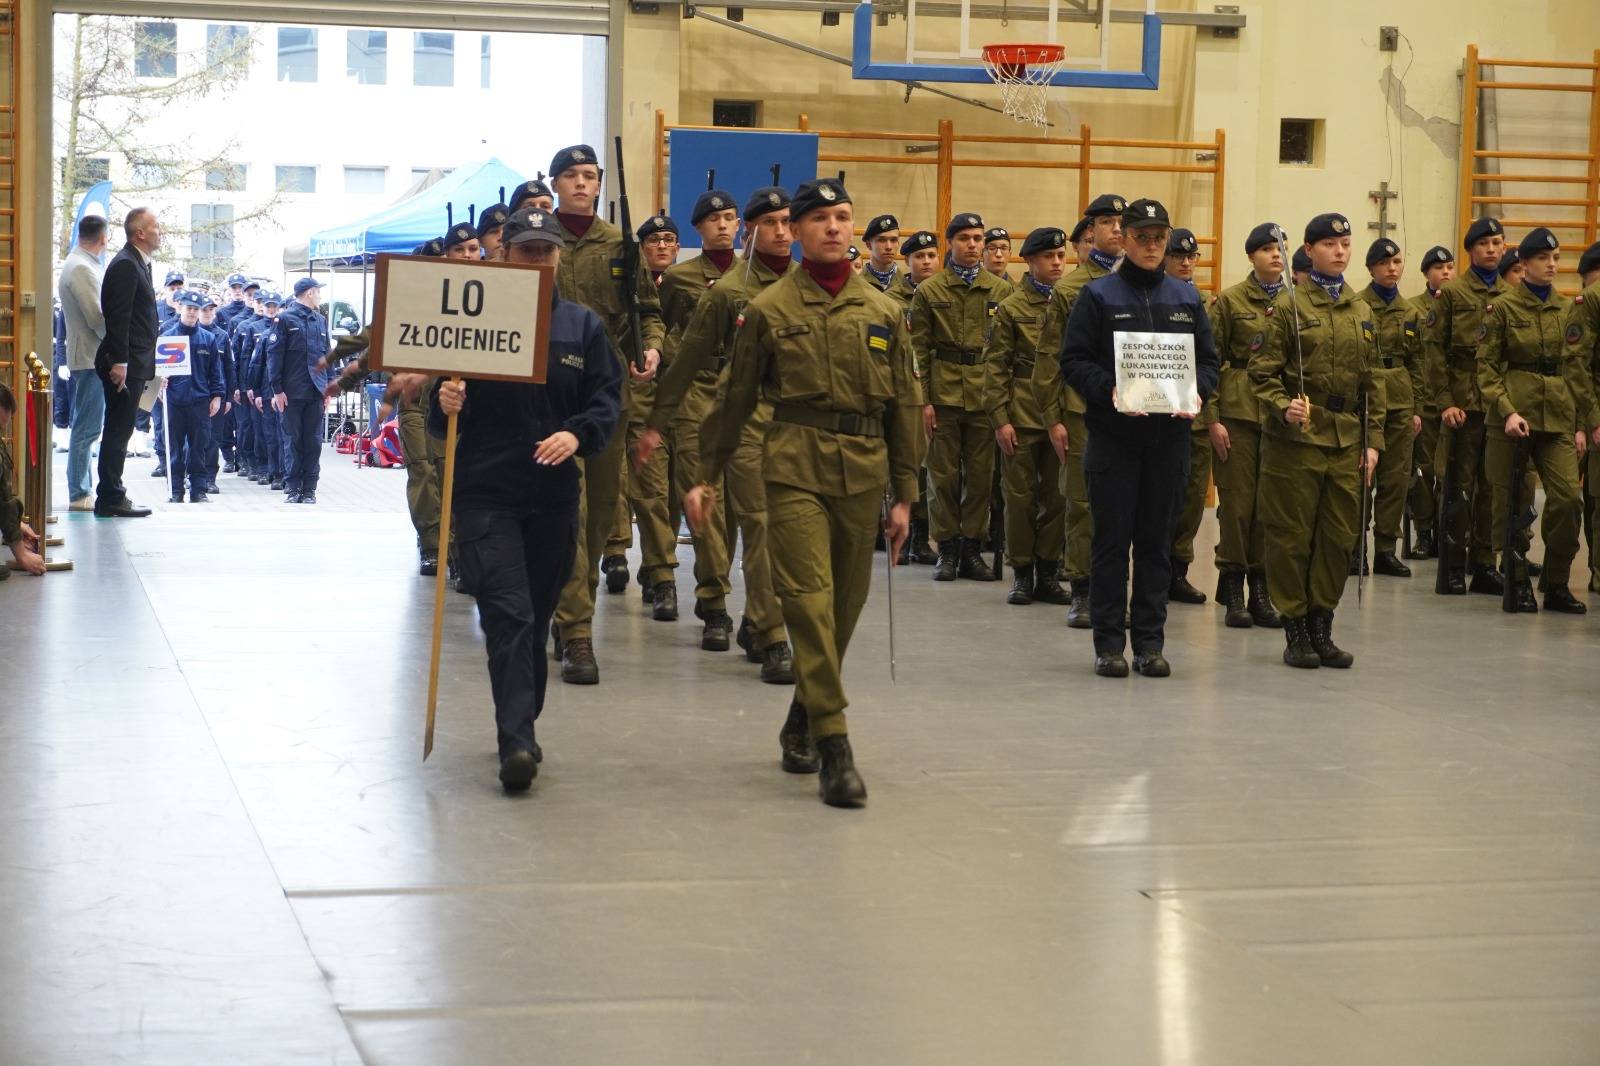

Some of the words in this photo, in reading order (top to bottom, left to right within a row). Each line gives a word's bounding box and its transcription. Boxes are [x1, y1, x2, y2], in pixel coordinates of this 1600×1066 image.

[440, 278, 485, 317] LO
[398, 323, 521, 354] ZŁOCIENIEC
[1121, 342, 1155, 351] ZESPÓŁ
[1157, 342, 1187, 351] SZKÓŁ
[1122, 352, 1136, 360] IM.
[1138, 353, 1187, 361] IGNACEGO
[1121, 362, 1190, 370] ŁUKASIEWICZA
[1139, 372, 1185, 380] POLICACH
